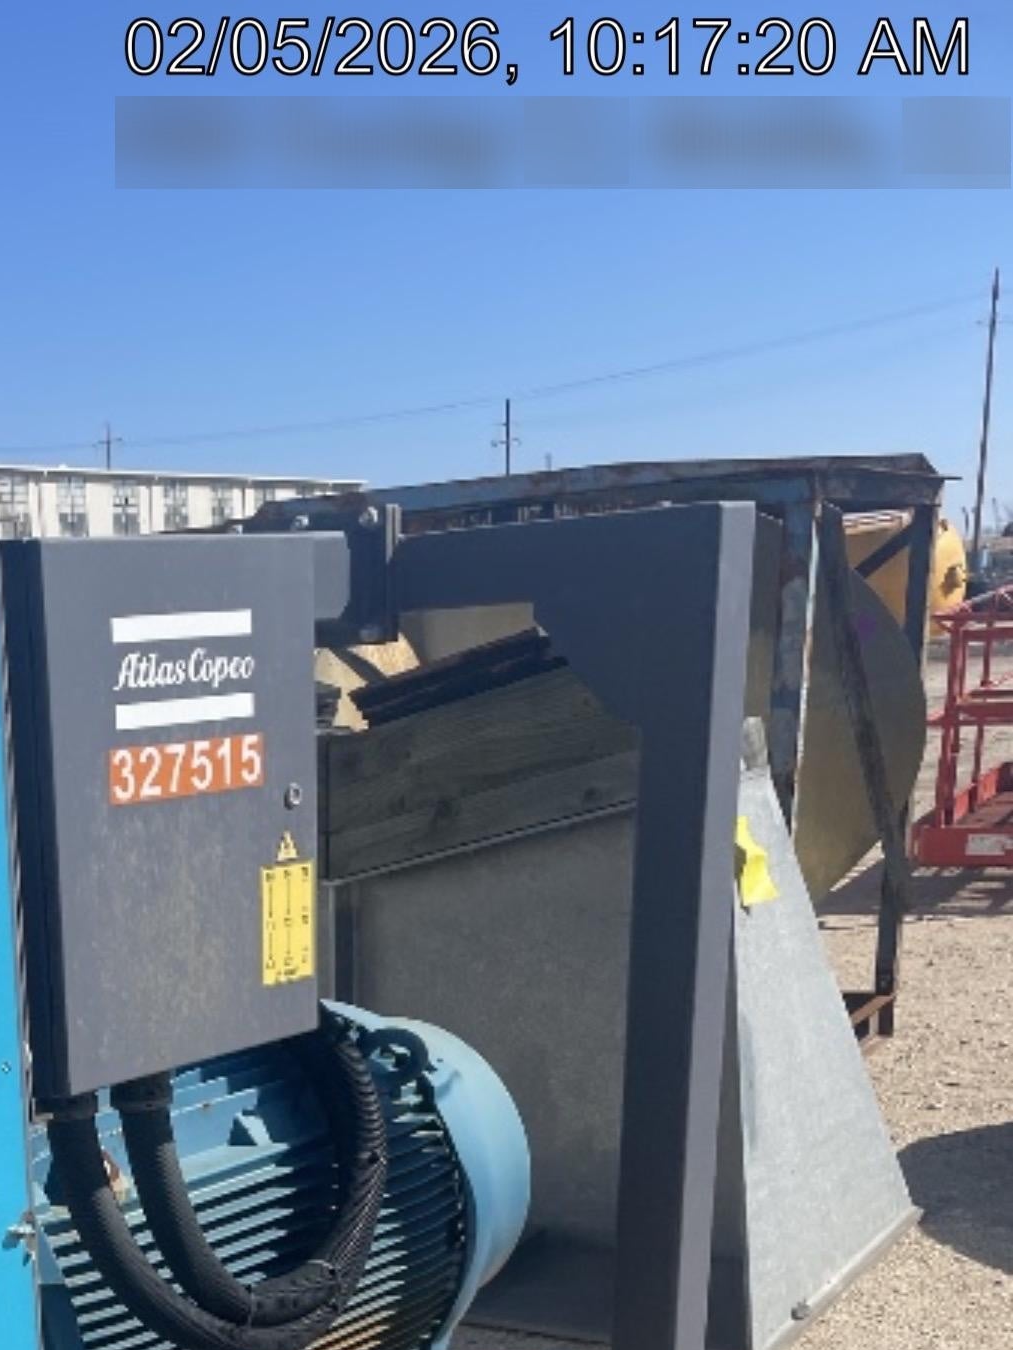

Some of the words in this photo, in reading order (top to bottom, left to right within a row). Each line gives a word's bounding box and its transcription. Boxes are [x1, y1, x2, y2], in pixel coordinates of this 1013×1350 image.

[112, 652, 187, 691] Atlas
[187, 647, 255, 689] Copco
[111, 734, 262, 801] 327515
